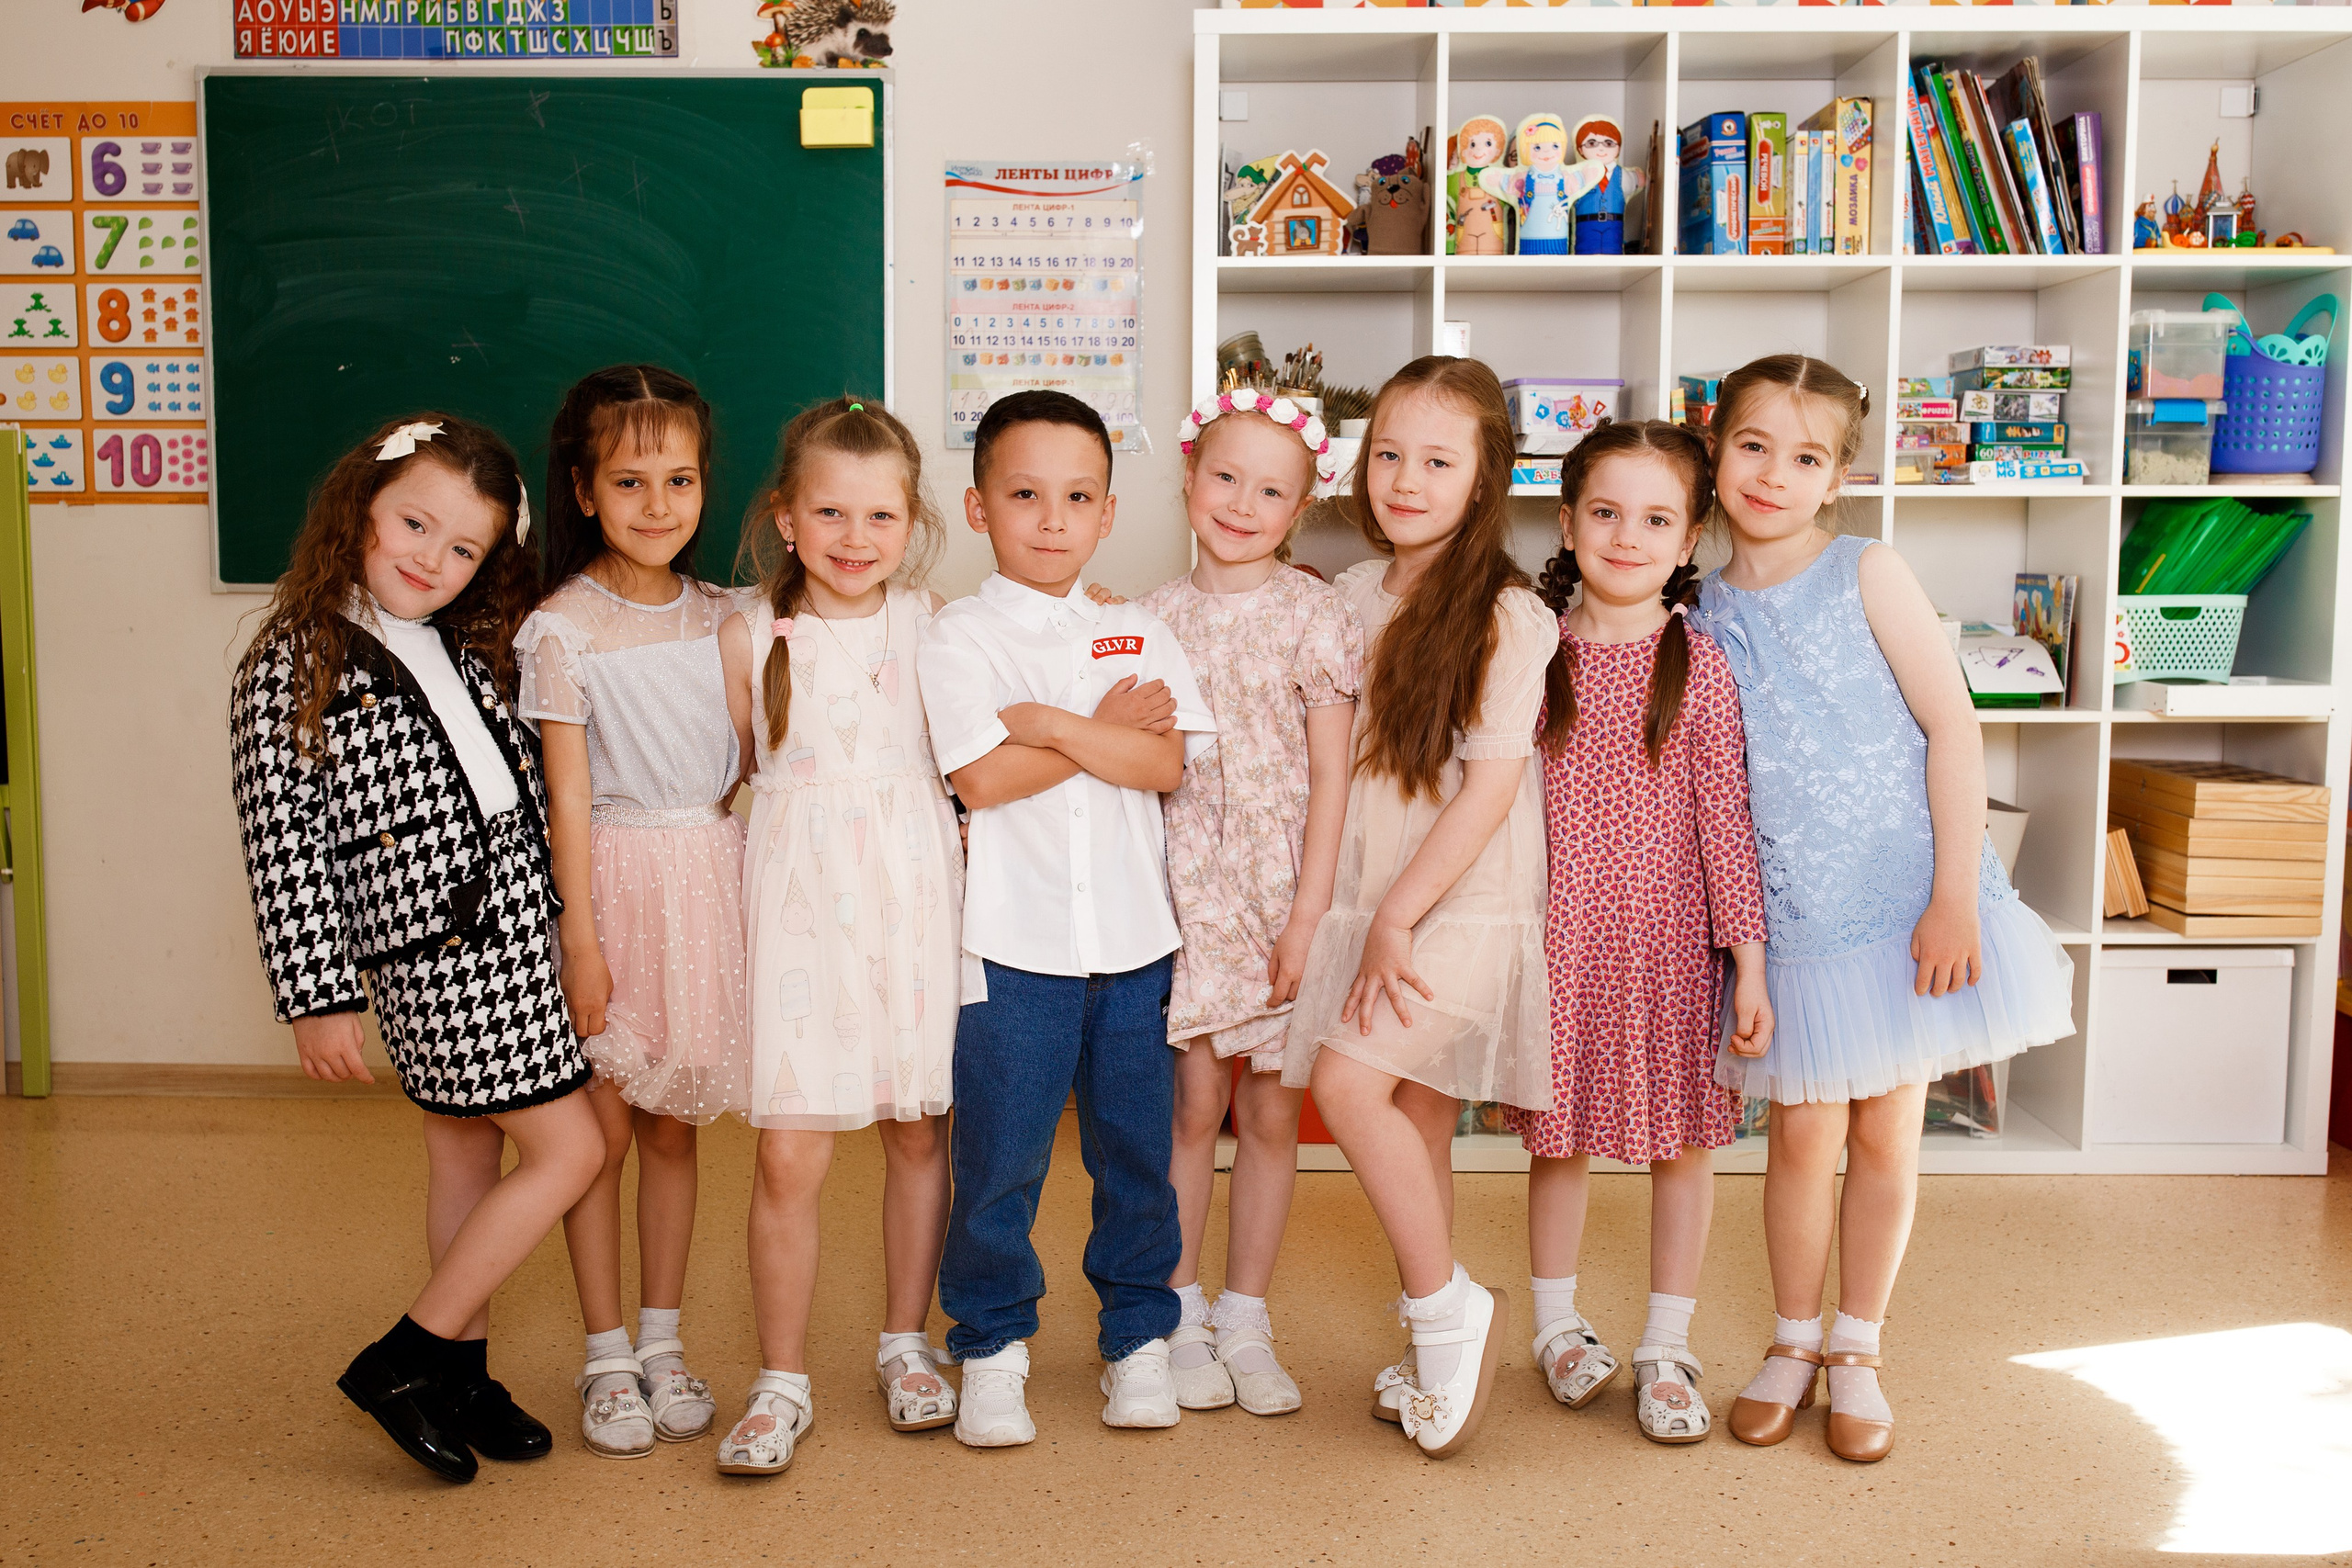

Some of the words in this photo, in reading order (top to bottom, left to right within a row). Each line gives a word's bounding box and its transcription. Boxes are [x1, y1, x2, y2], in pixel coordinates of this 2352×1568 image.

[237, 0, 254, 23] А
[257, 0, 275, 23] О
[281, 0, 296, 23] У
[300, 0, 316, 23] Ы
[321, 0, 334, 23] Э
[341, 0, 356, 23] Н
[359, 0, 379, 23] М
[382, 0, 399, 23] Л
[407, 0, 418, 23] Р
[447, 0, 458, 23] Б
[468, 0, 479, 23] В
[488, 0, 497, 23] Г
[506, 0, 525, 25] Д
[527, 0, 548, 23] Ж
[551, 0, 564, 23] З
[240, 29, 252, 53] Я
[261, 27, 272, 53] Ё
[278, 29, 298, 53] Ю
[300, 29, 315, 53] И
[322, 29, 334, 53] Е
[447, 29, 460, 53] П
[464, 29, 483, 53] Ф
[489, 29, 503, 53] К
[510, 29, 522, 53] Т
[528, 29, 548, 53] Ш
[552, 29, 566, 53] С
[573, 29, 588, 53] Х
[594, 29, 611, 55] Ц
[616, 29, 629, 53] Ч
[634, 29, 655, 55] Щ
[658, 29, 672, 51] Ъ
[10, 108, 64, 130] СЧЁТ
[77, 113, 107, 132] ДО
[119, 113, 139, 130] 10
[2079, 116, 2088, 163] ВИКТОРИНА
[91, 141, 127, 197] 6
[995, 168, 1059, 180] ЛЕНТЫ
[1064, 168, 1114, 183] ЦИФР
[1760, 152, 1769, 191] РЕЧЕВОЙ
[1012, 203, 1040, 211] ЛЕНТА
[1043, 204, 1075, 212] ЦИФР-1
[1849, 174, 1859, 226] МОЗАИКА
[1924, 180, 1949, 225] Юный
[956, 217, 961, 227] 1
[973, 217, 980, 227] 2
[991, 217, 999, 227] 3
[1010, 217, 1018, 227] 4
[1029, 217, 1036, 227] 5
[1047, 217, 1055, 227] 6
[1067, 217, 1074, 227] 7
[1085, 217, 1092, 227] 8
[1104, 217, 1111, 227] 9
[1120, 217, 1133, 227] 10
[92, 215, 130, 269] 7
[954, 256, 965, 267] 11
[972, 256, 985, 267] 12
[990, 256, 1003, 267] 13
[1010, 256, 1022, 267] 14
[1028, 256, 1041, 267] 15
[1046, 256, 1059, 267] 16
[1065, 256, 1078, 267] 17
[1084, 256, 1096, 267] 18
[1102, 256, 1115, 267] 19
[1121, 256, 1134, 267] 20
[96, 288, 132, 343] 8
[1043, 303, 1075, 311] ЦИФР-2
[955, 317, 962, 328] 0
[973, 317, 978, 328] 1
[989, 317, 996, 328] 2
[1007, 317, 1014, 328] 3
[1023, 317, 1031, 328] 4
[1040, 317, 1047, 328] 5
[1057, 317, 1064, 328] 6
[1075, 317, 1081, 328] 7
[1108, 317, 1115, 328] 9
[1122, 317, 1135, 328] 10
[953, 335, 965, 346] 10
[969, 335, 981, 346] 11
[986, 335, 999, 346] 12
[1003, 335, 1016, 346] 13
[1021, 335, 1034, 346] 14
[1037, 335, 1050, 346] 15
[1054, 335, 1067, 346] 16
[1071, 335, 1084, 346] 17
[1089, 335, 1101, 346] 18
[1105, 335, 1118, 346] 19
[1122, 335, 1135, 346] 20
[99, 361, 135, 415] 9
[977, 391, 989, 409] 2
[953, 412, 966, 422] 10
[970, 412, 984, 422] 20
[1927, 407, 1953, 415] PUZZLE
[96, 434, 163, 488] 10
[1979, 447, 1994, 458] 60
[1092, 638, 1137, 654] GLVR
